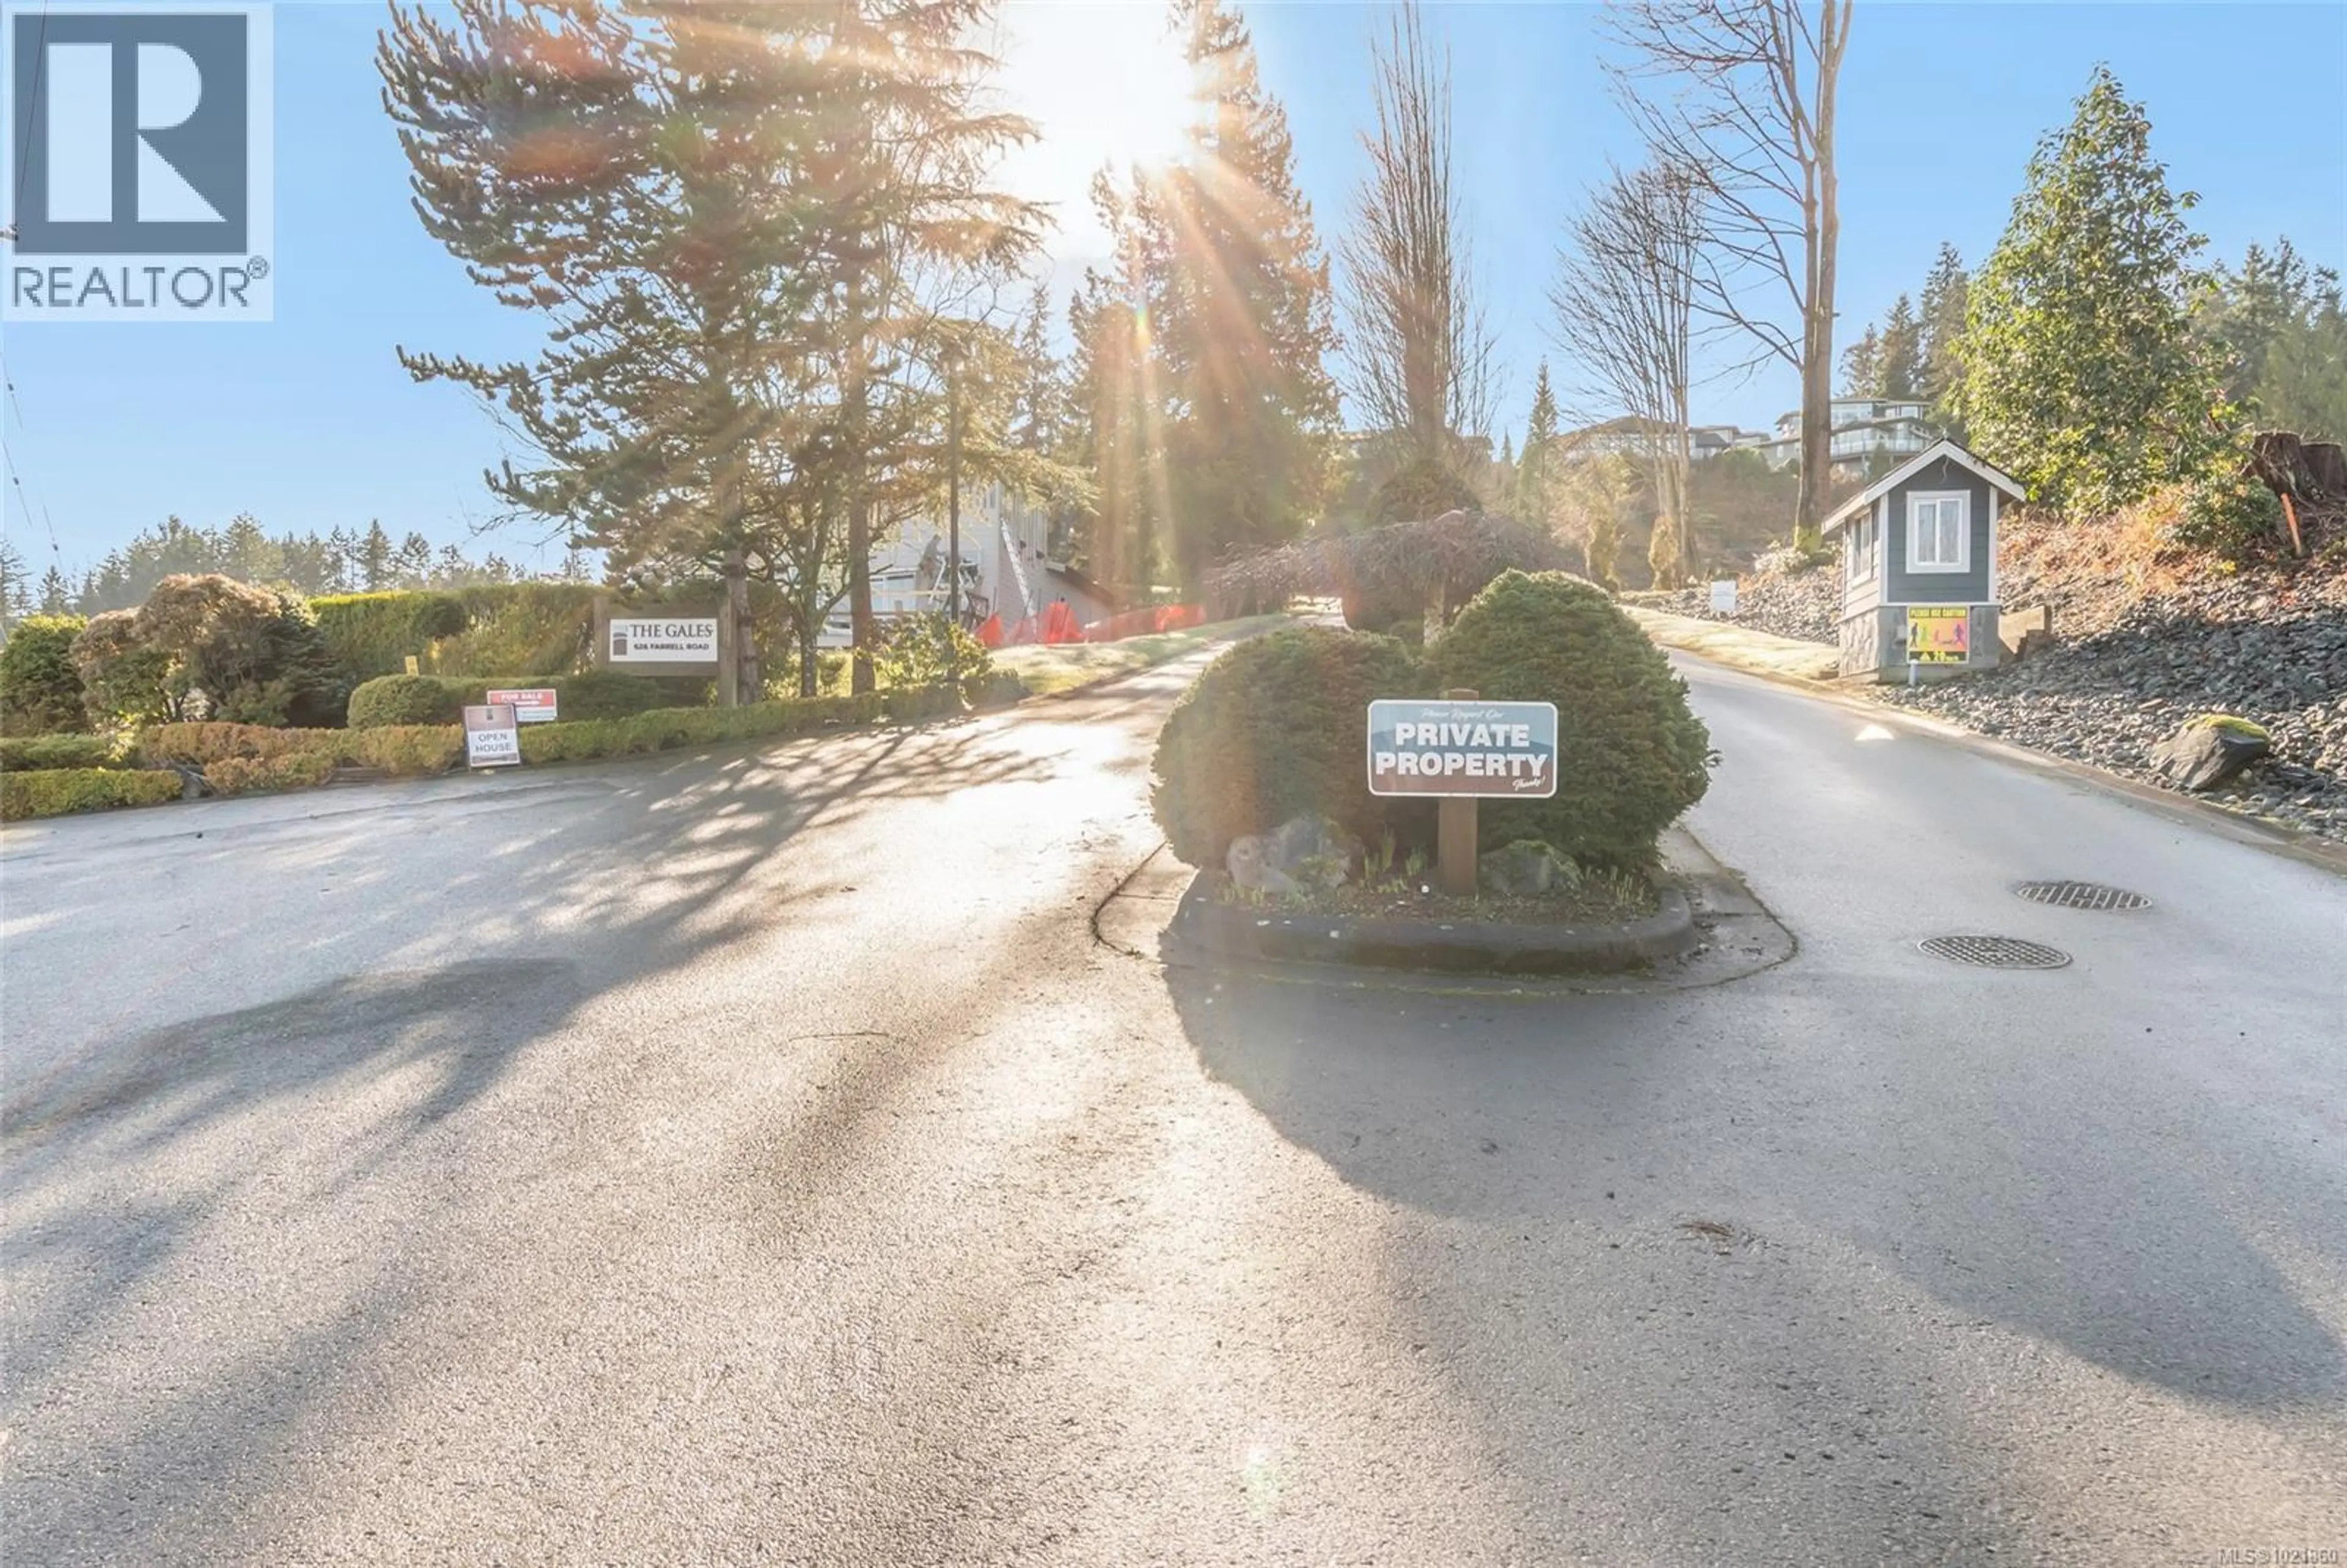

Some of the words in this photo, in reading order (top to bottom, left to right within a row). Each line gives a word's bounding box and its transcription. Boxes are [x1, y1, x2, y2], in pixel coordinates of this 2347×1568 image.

[630, 623, 661, 637] THE
[666, 623, 713, 638] GALES
[478, 733, 507, 741] OPEN
[1396, 722, 1530, 747] PRIVATE
[475, 742, 512, 752] HOUSE
[1376, 752, 1548, 777] PROPERTY
